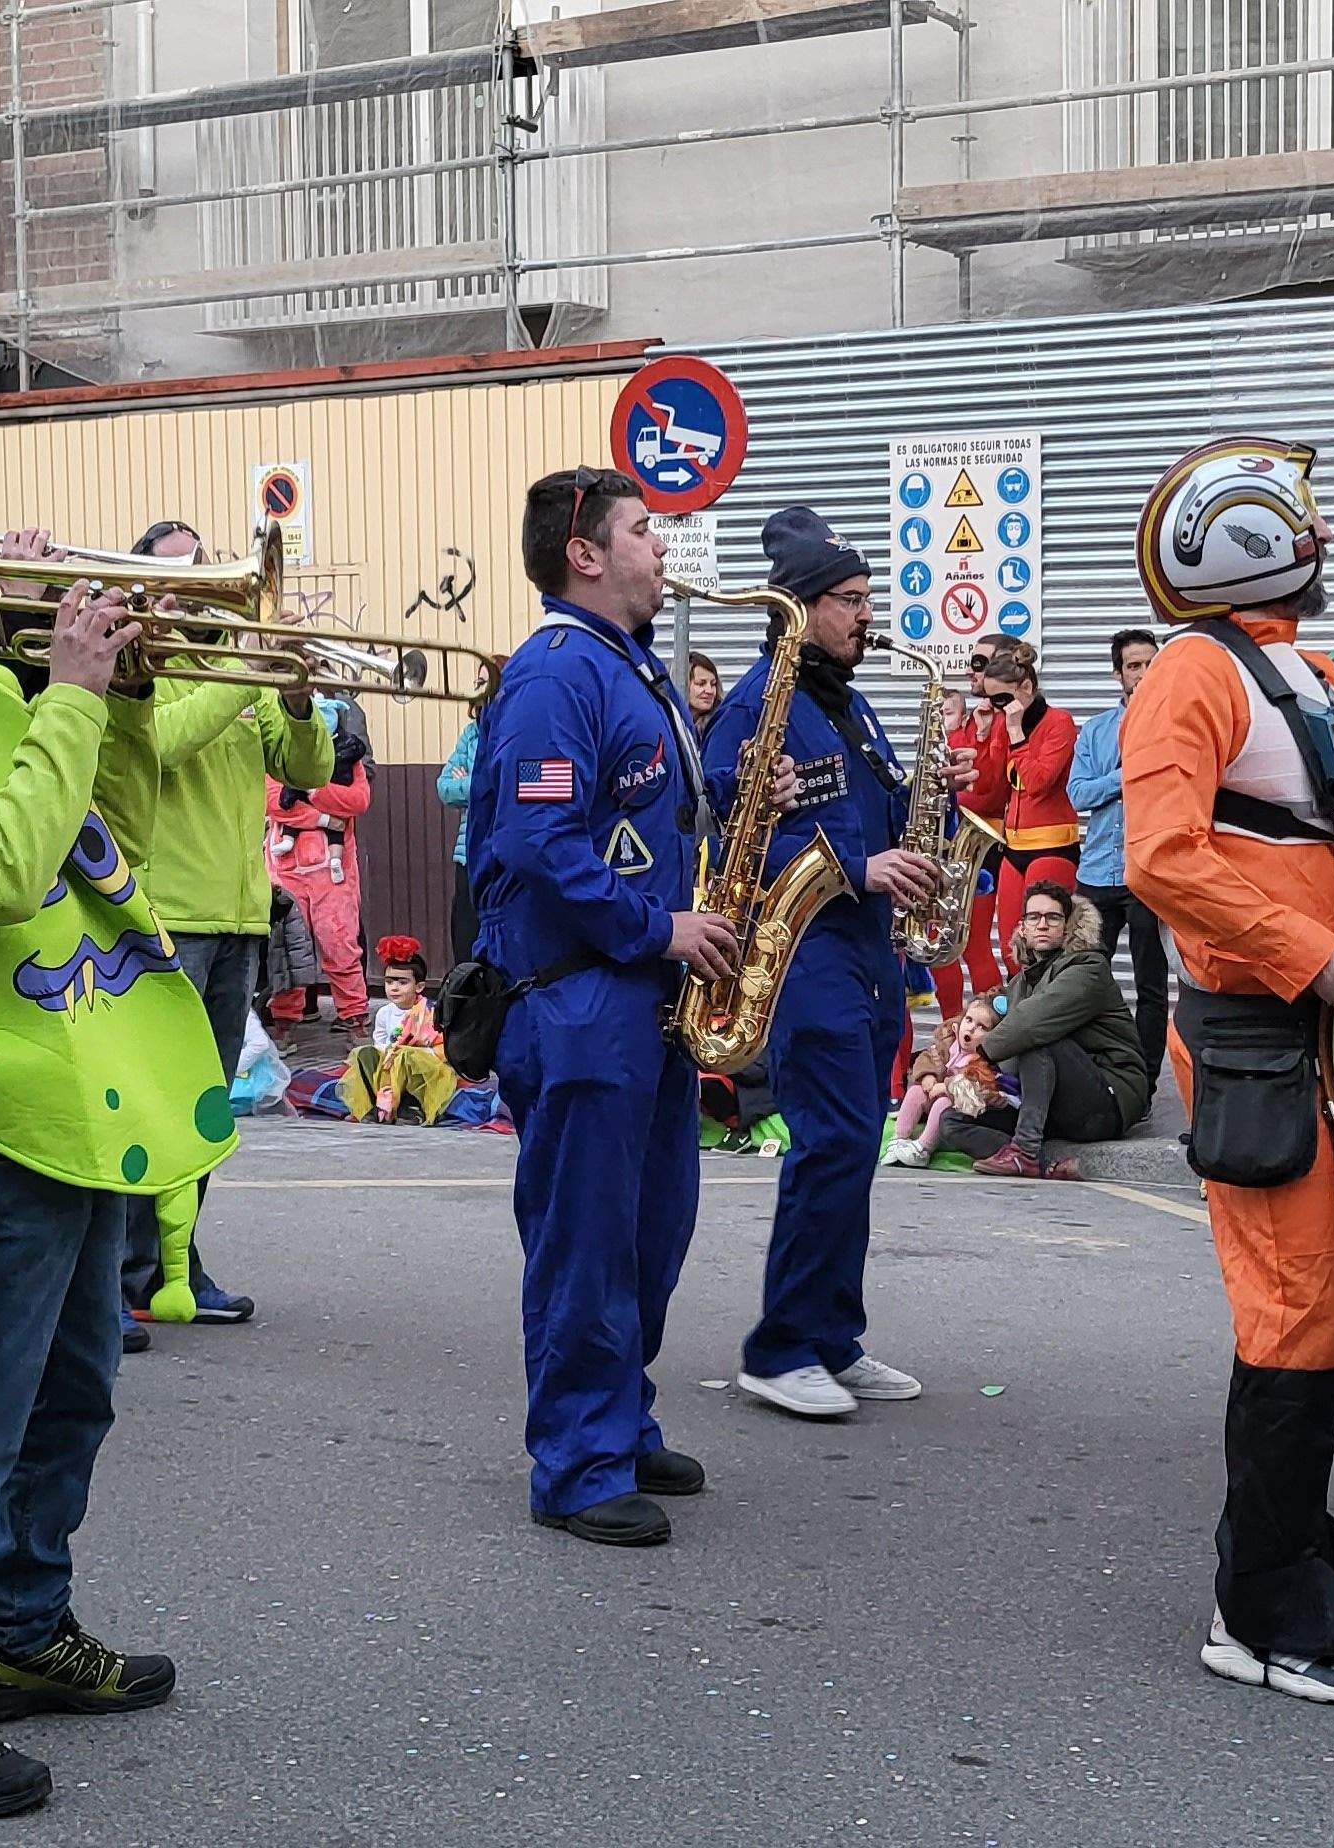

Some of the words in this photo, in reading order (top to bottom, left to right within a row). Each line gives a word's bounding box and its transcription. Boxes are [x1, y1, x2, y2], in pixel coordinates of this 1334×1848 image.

[896, 445, 907, 455] ES
[912, 442, 967, 455] OBLIGATORIO
[970, 440, 1001, 452] SEGUIR
[1004, 438, 1031, 450] TODAS
[905, 458, 920, 468] LAS
[923, 455, 958, 467] NORMAS
[960, 455, 972, 466] DE
[974, 453, 1023, 465] SEGURIDAD
[653, 516, 703, 529] LABORABLES
[672, 533, 678, 544] A
[680, 532, 702, 543] 20:00
[680, 547, 709, 558] CARGA
[664, 562, 702, 574] ESCARGA
[944, 571, 985, 581] Añaños
[953, 644, 965, 654] EL
[946, 659, 971, 670] AJEN
[618, 762, 667, 789] NASA
[807, 772, 833, 788] esa
